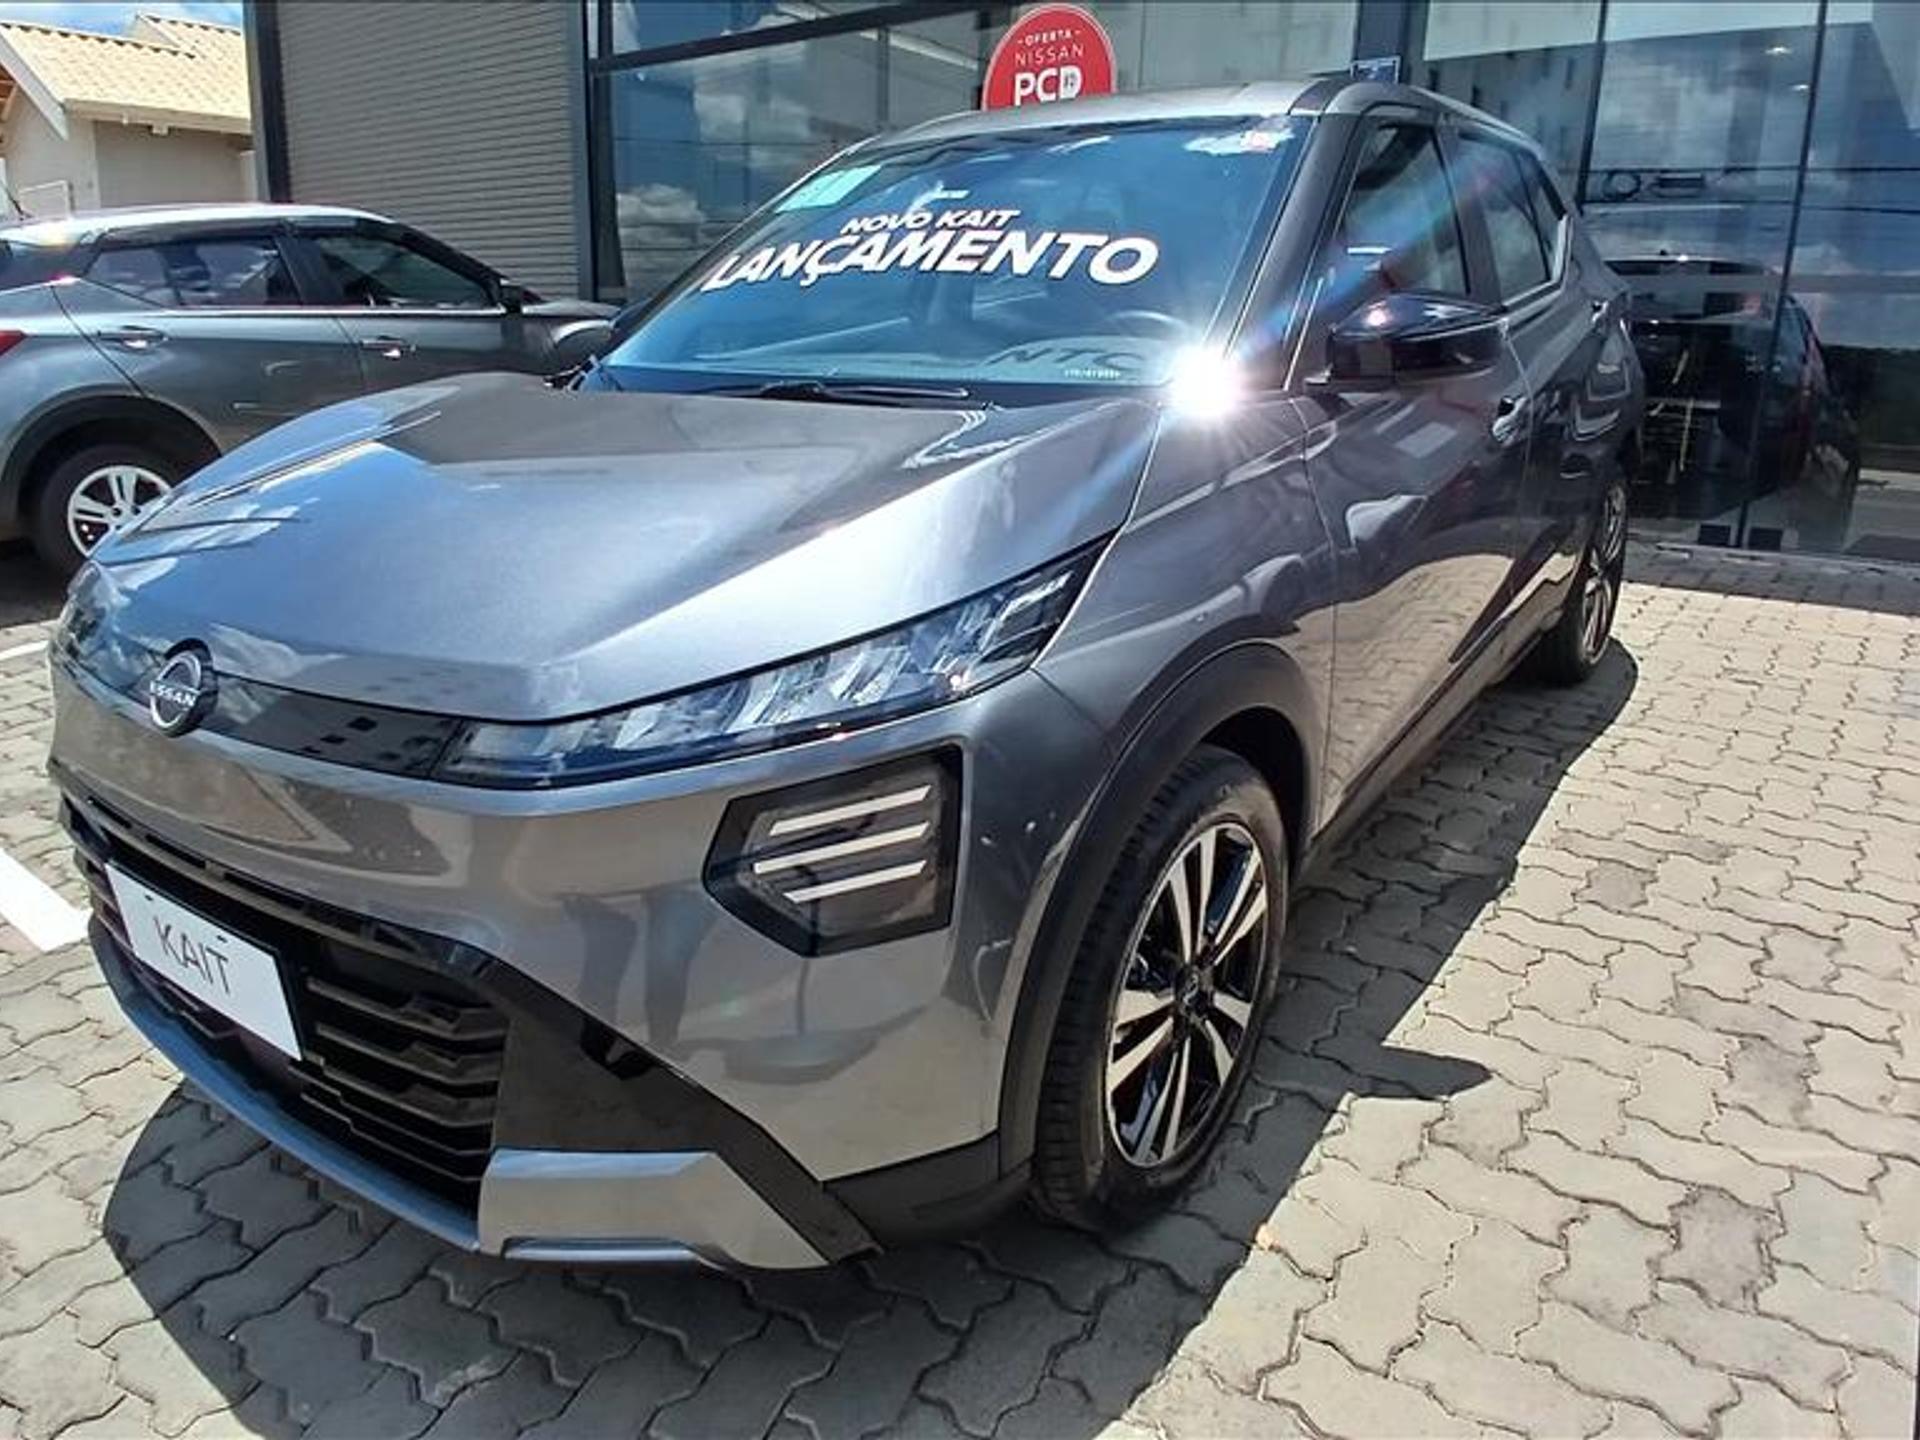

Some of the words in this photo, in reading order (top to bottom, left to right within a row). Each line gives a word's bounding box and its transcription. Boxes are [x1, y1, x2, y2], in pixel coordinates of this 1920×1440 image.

[1015, 43, 1084, 67] NISSAN
[1014, 65, 1082, 106] PCD
[840, 211, 932, 234] NOVO
[935, 209, 1021, 228] KAIT
[700, 230, 1160, 292] LANÇAMENTO
[154, 917, 231, 995] KAIT
